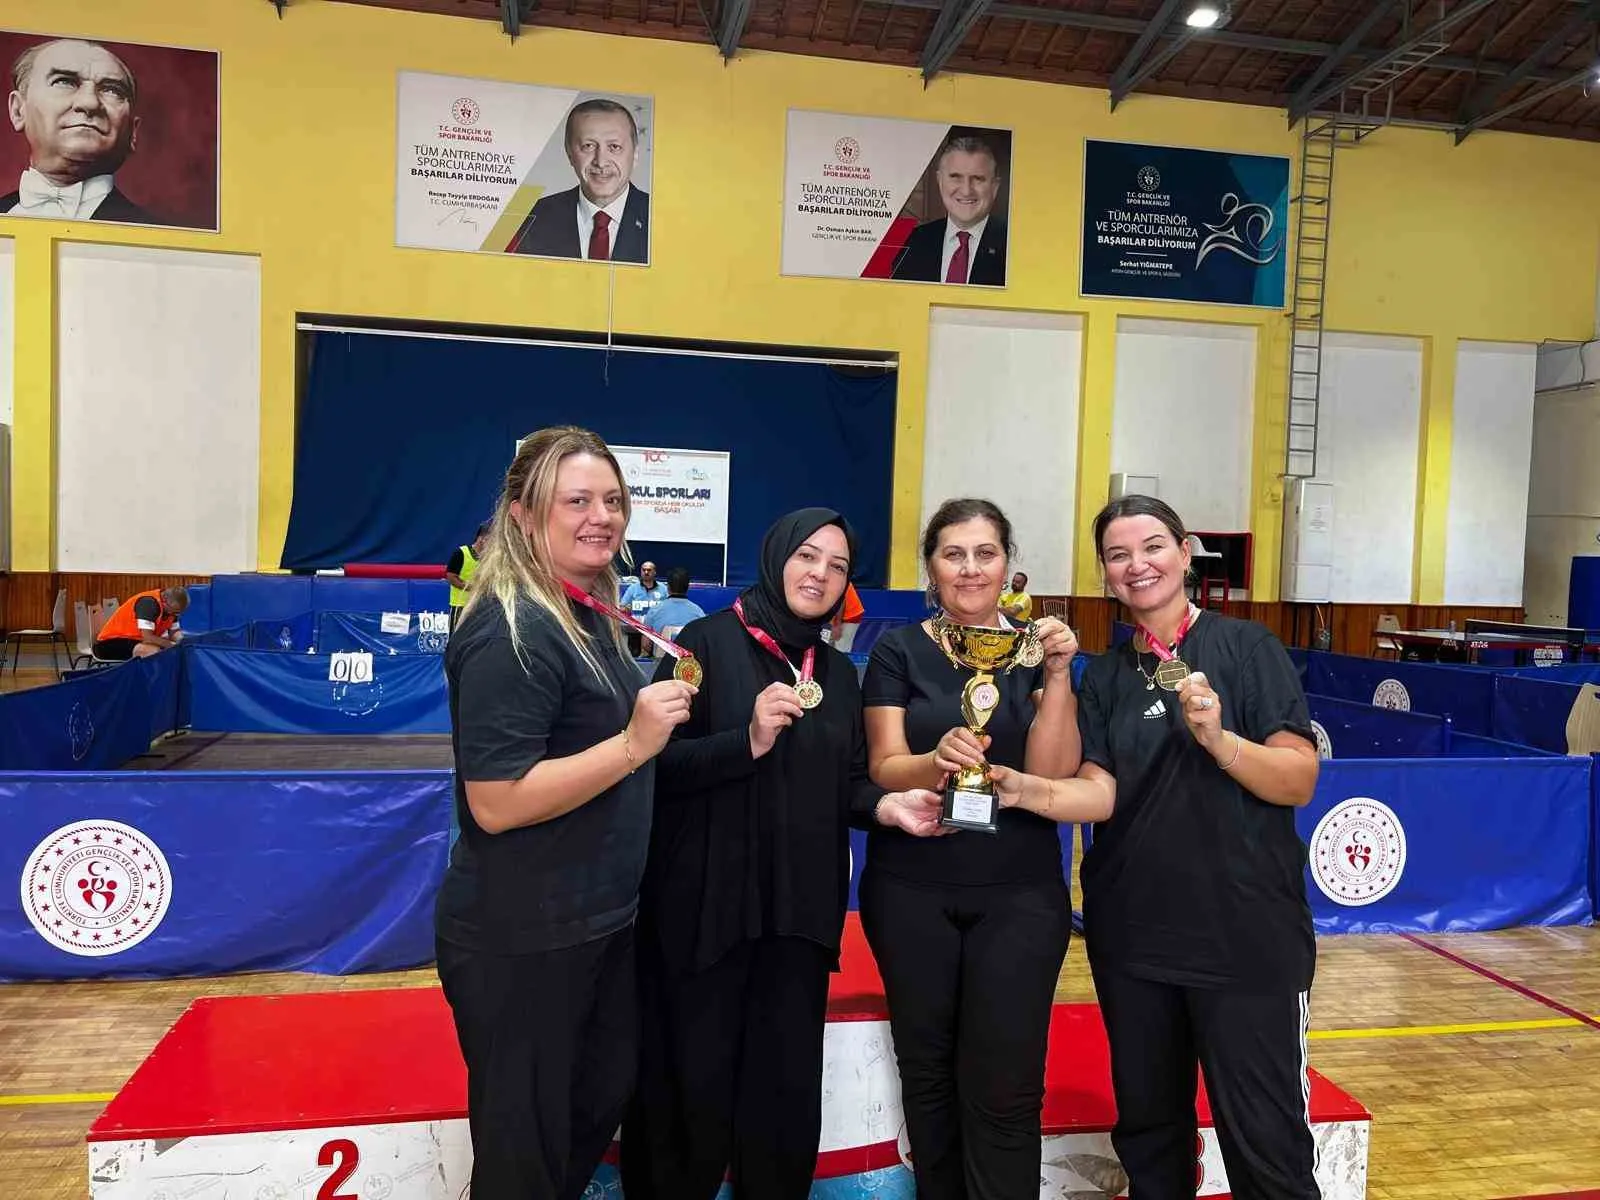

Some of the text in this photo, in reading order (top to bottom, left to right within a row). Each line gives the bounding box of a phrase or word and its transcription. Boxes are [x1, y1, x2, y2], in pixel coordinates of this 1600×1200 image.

[414, 144, 515, 164] TÜM ANTRENÖR VE
[417, 157, 512, 175] SPORCULARIMIZA
[411, 168, 517, 185] BAŞARILAR DİLİYORUM
[801, 182, 891, 199] TÜM ANTRENÖR VE
[803, 193, 887, 208] SPORCULARIMIZA
[798, 205, 892, 218] BAŞARILAR DİLİYORUM
[1108, 209, 1187, 226] TÜM ANTRENÖR
[1096, 221, 1199, 238] VE SPORCULARIMIZA
[1097, 235, 1196, 250] BAŞARILAR DİLİYORUM
[655, 486, 711, 500] SPORLARI
[333, 659, 368, 680] 0 0
[316, 1138, 360, 1199] 2
